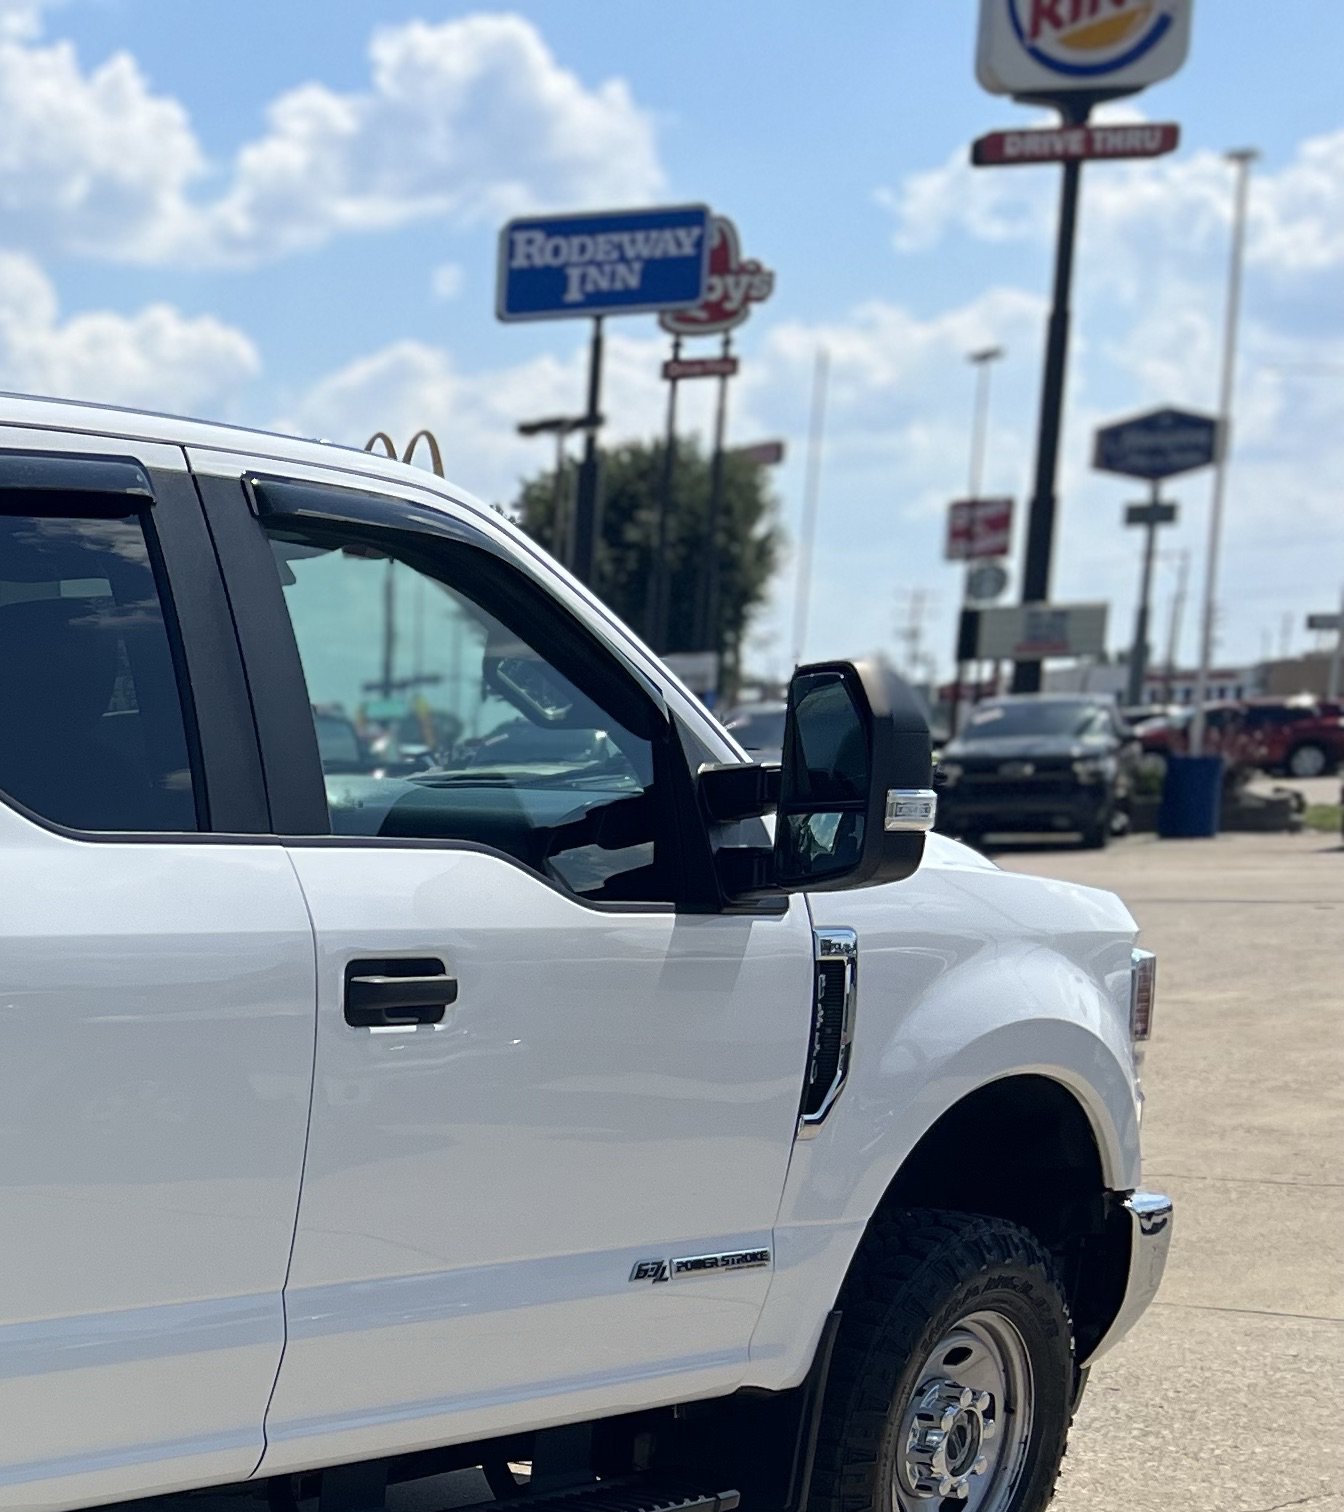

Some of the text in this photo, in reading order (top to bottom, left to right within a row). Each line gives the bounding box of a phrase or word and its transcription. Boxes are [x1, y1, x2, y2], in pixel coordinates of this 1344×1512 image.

[1004, 127, 1161, 157] DRIVE THRU
[511, 225, 703, 269] RODEWAY
[563, 262, 644, 304] INN
[675, 1256, 719, 1273] POWER
[720, 1249, 771, 1267] STROKE
